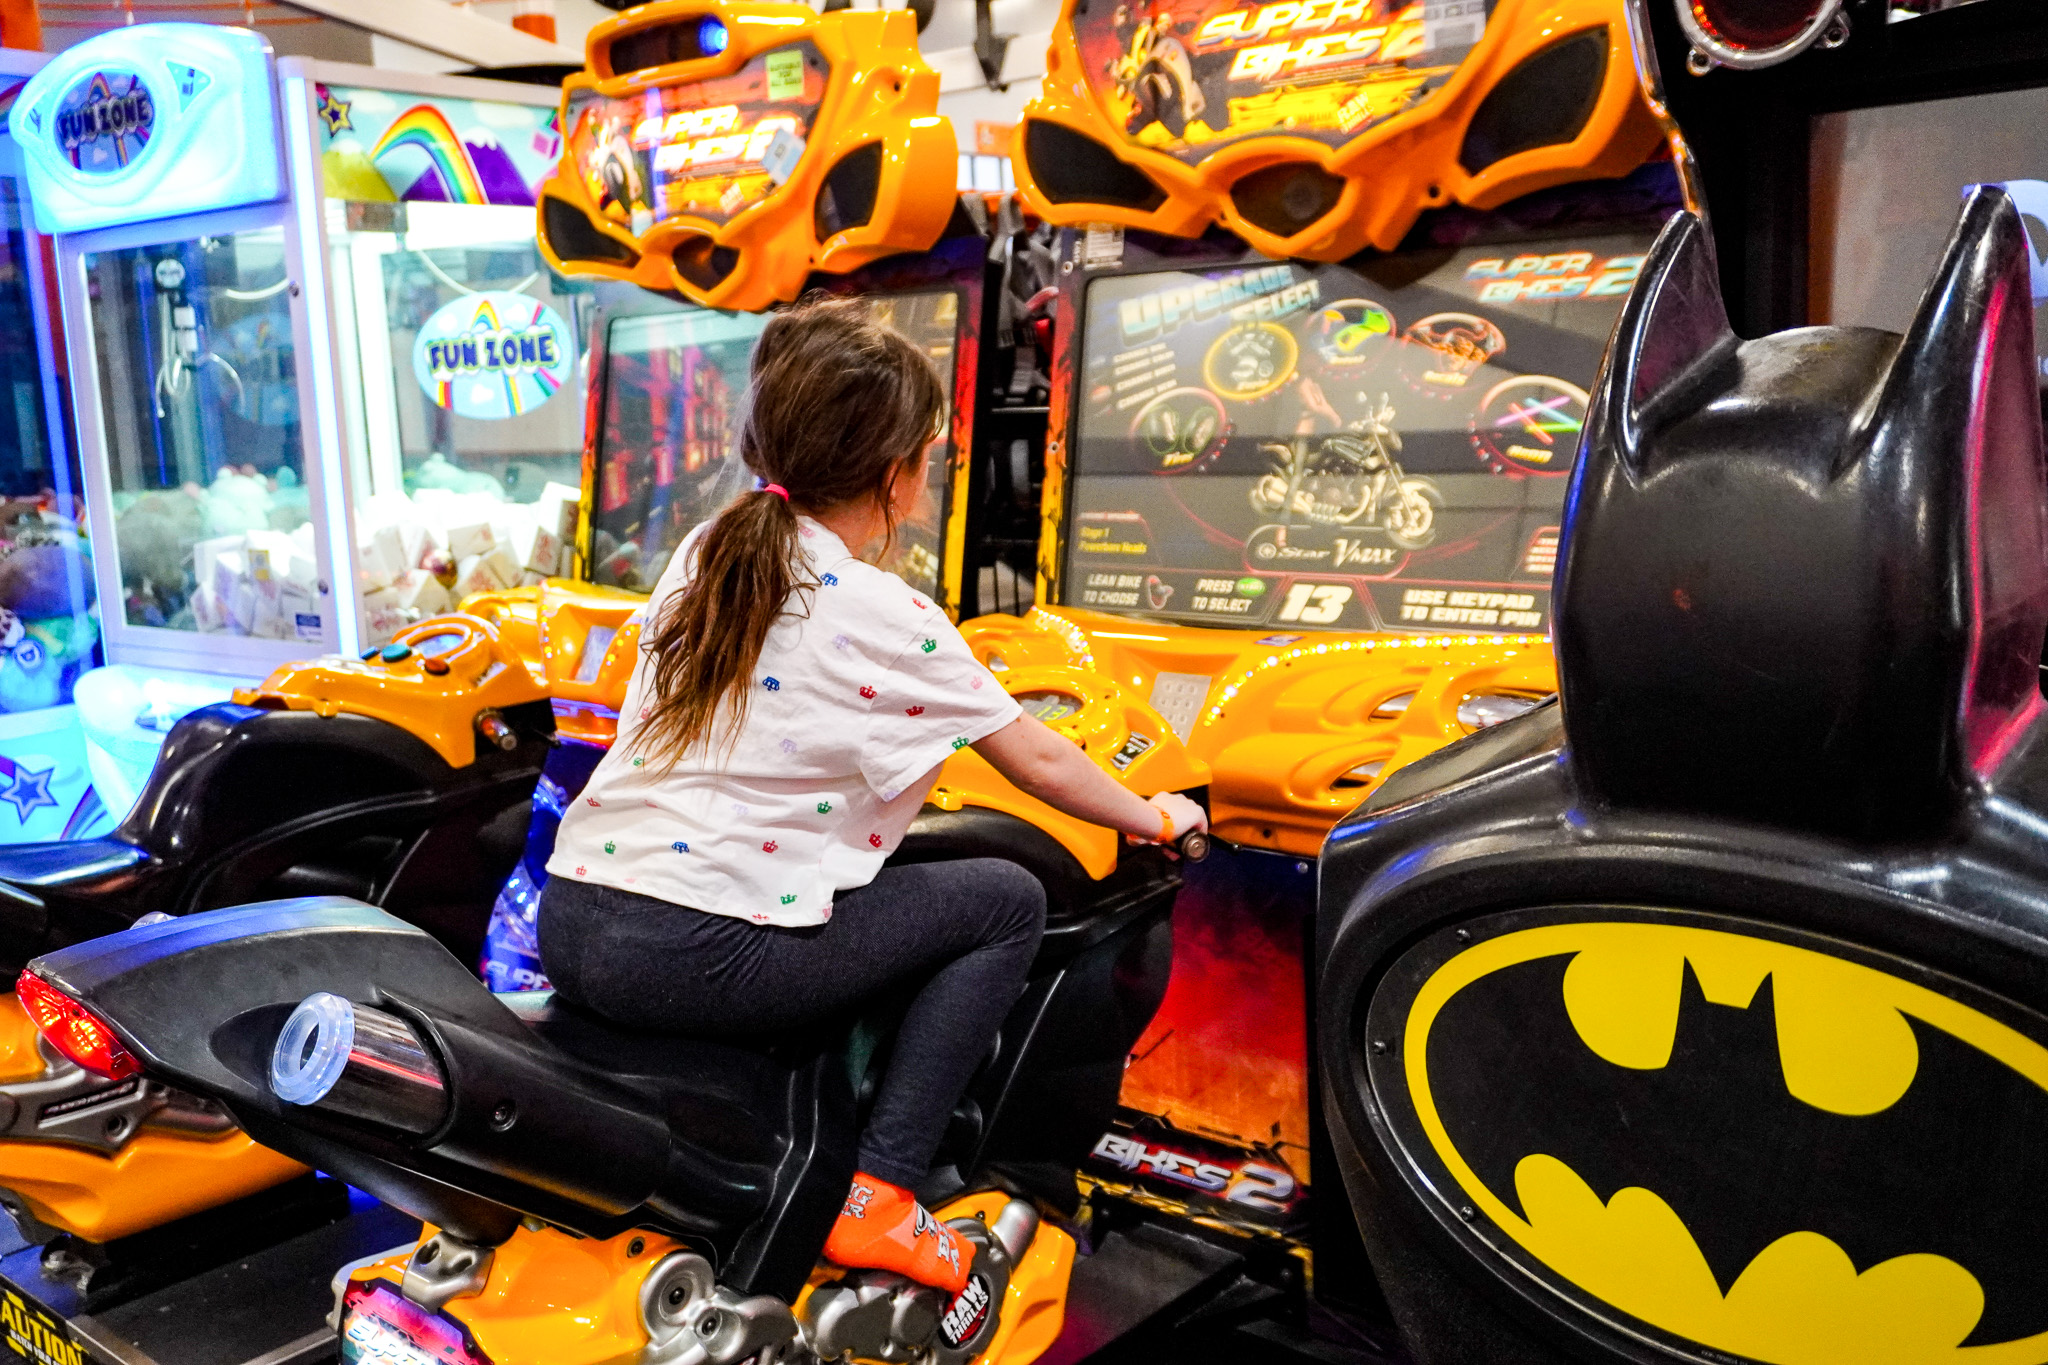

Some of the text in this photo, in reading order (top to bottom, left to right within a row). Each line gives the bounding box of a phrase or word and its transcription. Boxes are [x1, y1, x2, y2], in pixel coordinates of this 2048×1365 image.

[1197, 0, 1371, 46] SUPER
[1228, 27, 1387, 81] BIKES
[60, 97, 150, 140] FUN ZONE
[1337, 92, 1368, 123] RAW
[1465, 252, 1593, 280] SUPER
[1480, 255, 1648, 303] BIKES 2
[1119, 265, 1294, 337] UPGRADE
[1231, 279, 1320, 322] SELECT
[430, 334, 555, 370] FUN ZONE
[1277, 547, 1330, 559] Star
[1083, 590, 1140, 606] TO CHOOSE
[1087, 574, 1142, 588] LEAN BIKE
[1196, 579, 1235, 594] PRESS
[1404, 589, 1535, 610] USE KEYPAD
[1192, 596, 1252, 612] TO SELECT
[1278, 583, 1353, 623] 13
[1401, 604, 1542, 628] TO ENTER PIN
[1115, 752, 1133, 764] GAS
[1092, 1132, 1295, 1215] BIKES 2
[941, 1275, 986, 1338] RAW
[949, 1291, 989, 1345] THRILLS
[0, 1299, 83, 1365] AUTION
